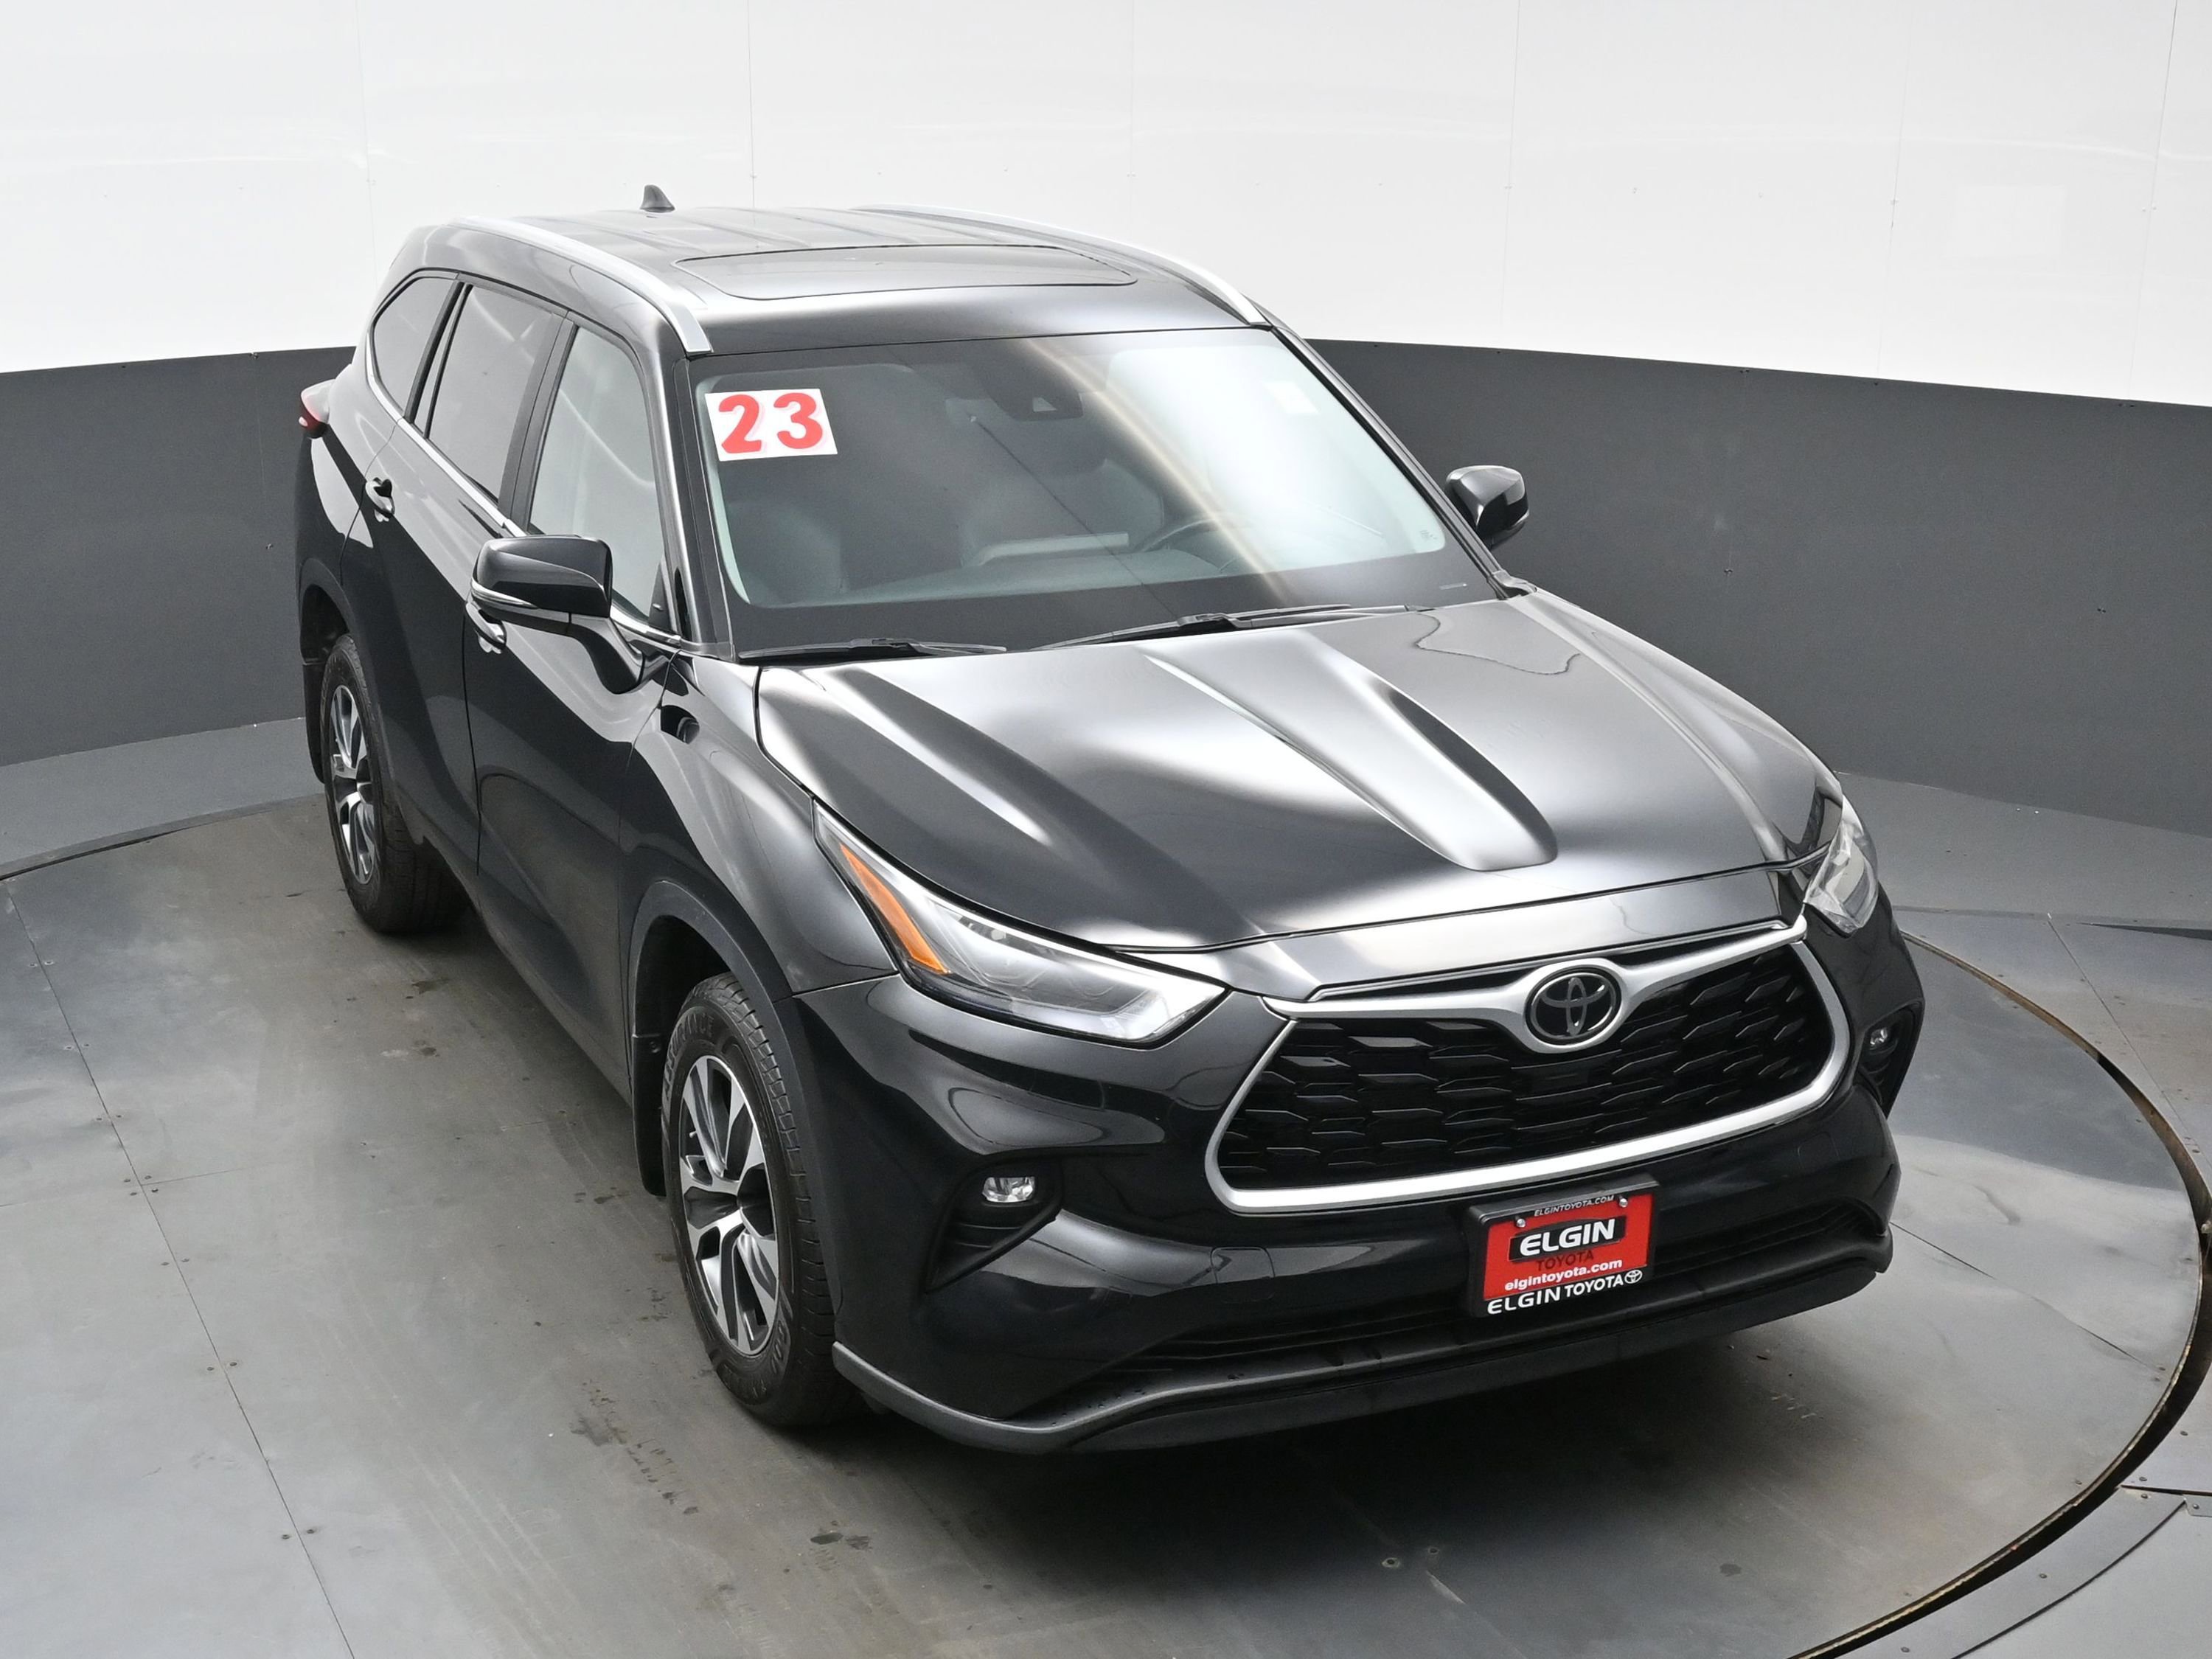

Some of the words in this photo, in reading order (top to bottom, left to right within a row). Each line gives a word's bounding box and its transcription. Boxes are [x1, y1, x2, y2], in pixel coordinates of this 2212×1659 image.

[718, 392, 824, 454] 23
[1534, 1194, 1615, 1217] ELGINTOYOTA.COM
[1520, 1219, 1615, 1256] ELGIN
[1504, 1259, 1622, 1291] elgintoyota.com
[1536, 1250, 1594, 1271] TOYOTA
[1487, 1288, 1560, 1315] ELGIN
[1564, 1274, 1624, 1297] TOYOTA
